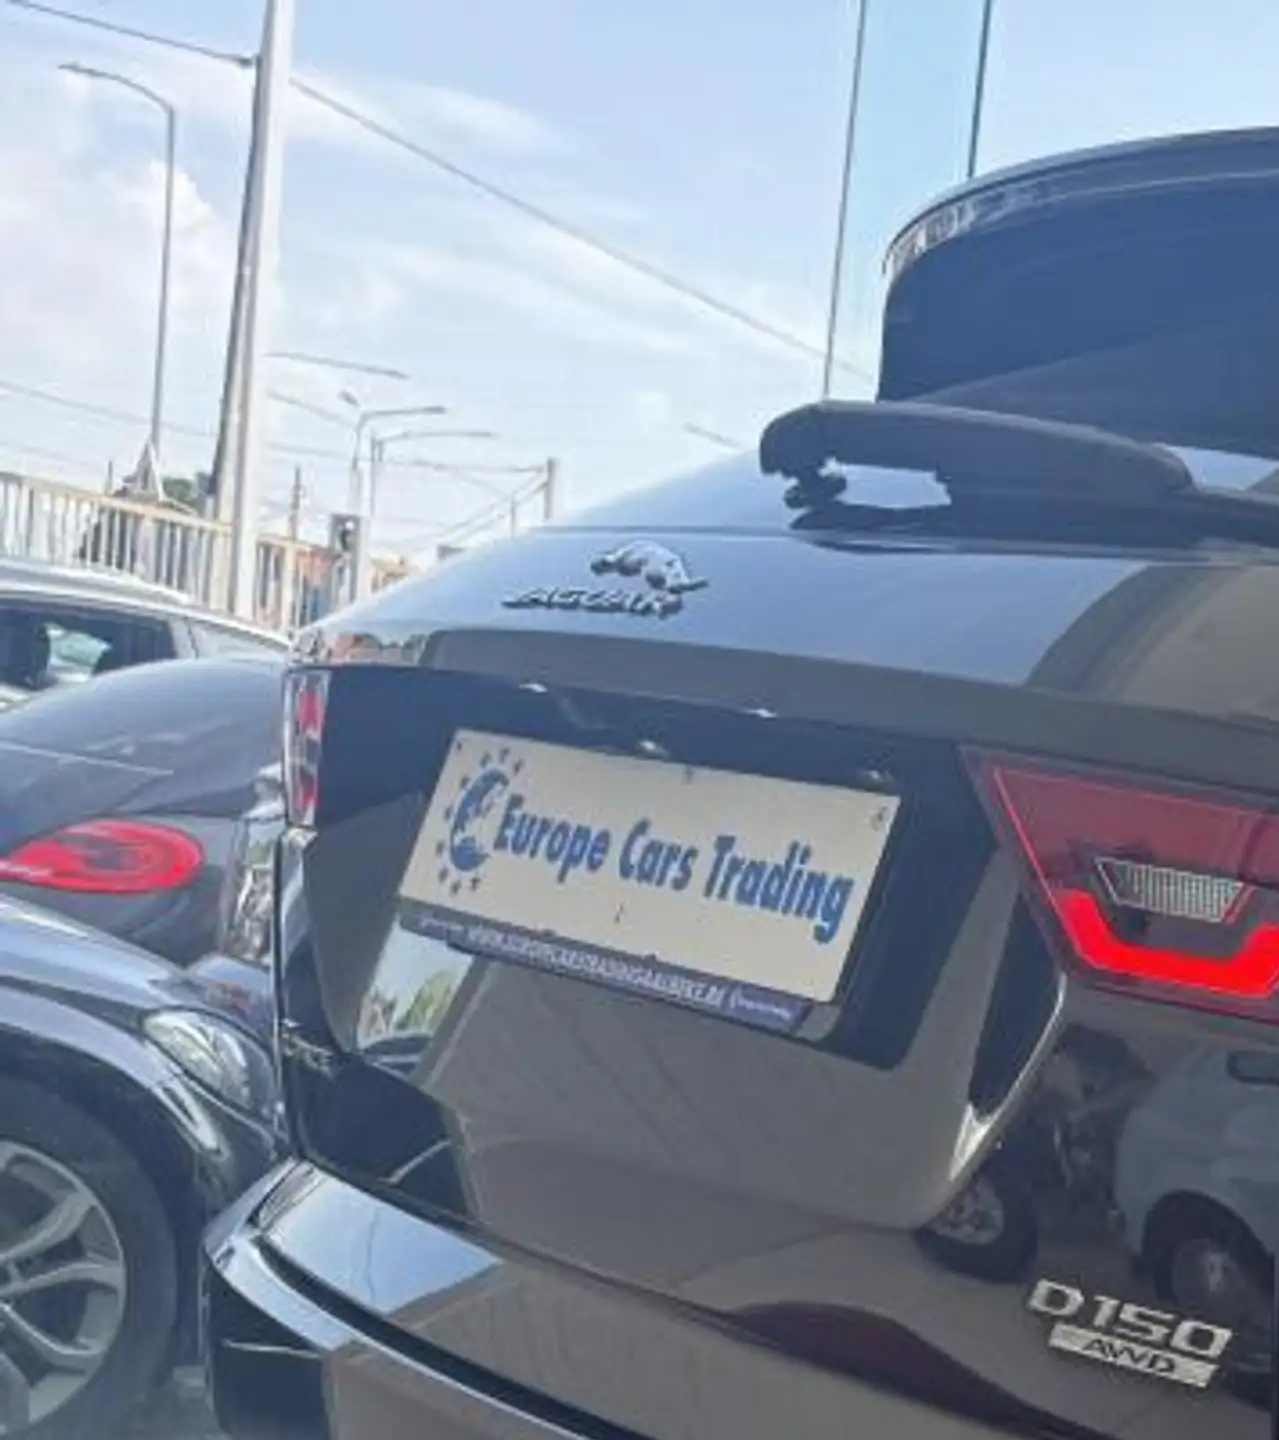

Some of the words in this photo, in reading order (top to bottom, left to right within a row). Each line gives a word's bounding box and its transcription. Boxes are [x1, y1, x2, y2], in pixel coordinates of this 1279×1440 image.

[493, 793, 611, 884] Europe
[618, 817, 698, 891] Cars
[702, 833, 855, 945] Trading
[1028, 1277, 1234, 1359] D150
[1082, 1338, 1177, 1374] AWD
